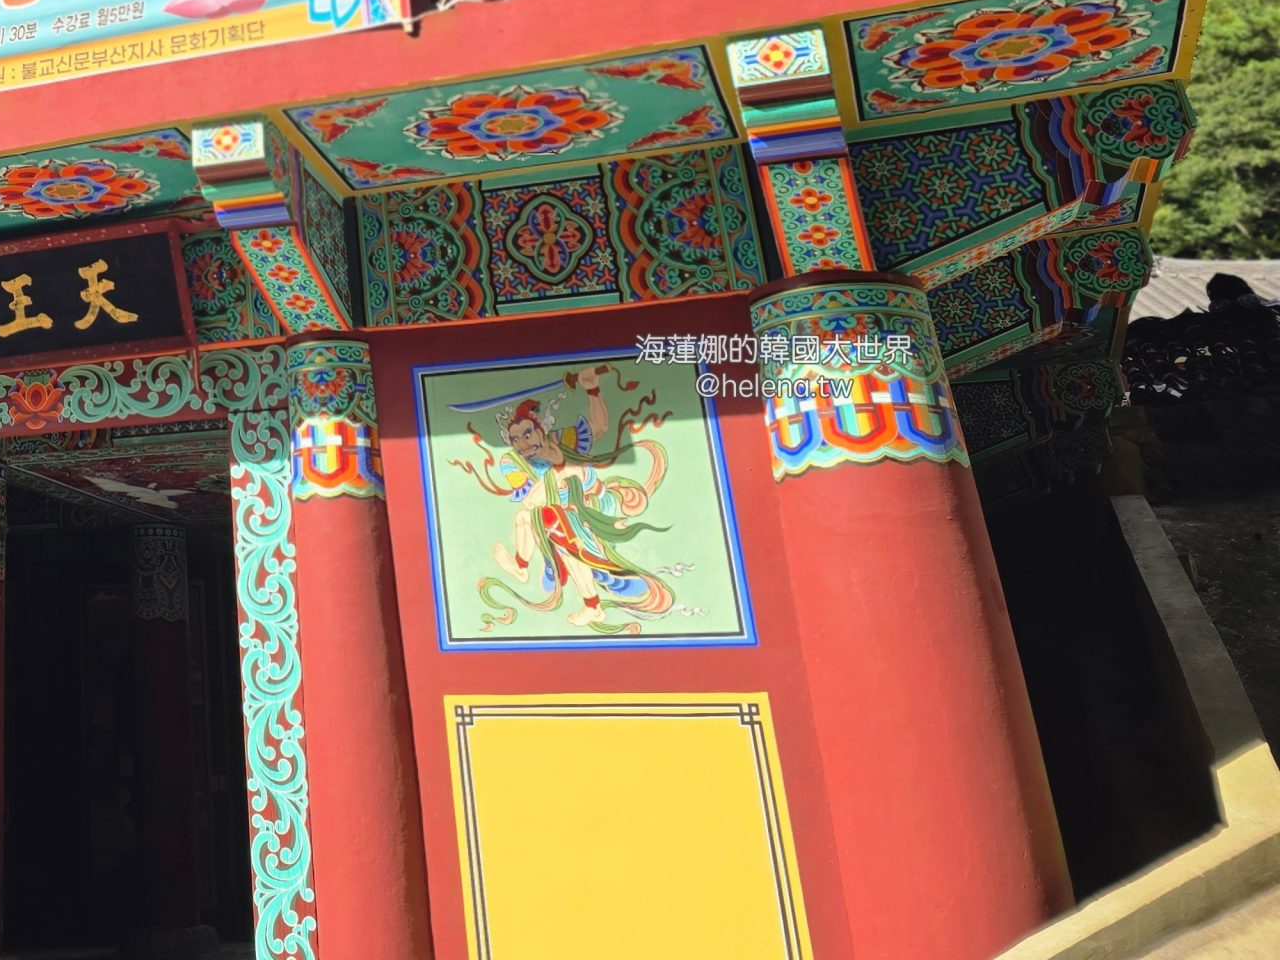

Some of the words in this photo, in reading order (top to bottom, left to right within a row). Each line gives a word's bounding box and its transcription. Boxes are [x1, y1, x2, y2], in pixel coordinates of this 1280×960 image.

[9, 21, 38, 42] 30분
[52, 12, 91, 35] 수강료
[96, 0, 145, 26] 월5만원
[21, 38, 164, 81] 불교신문부산지사
[170, 20, 266, 56] 문화기획단
